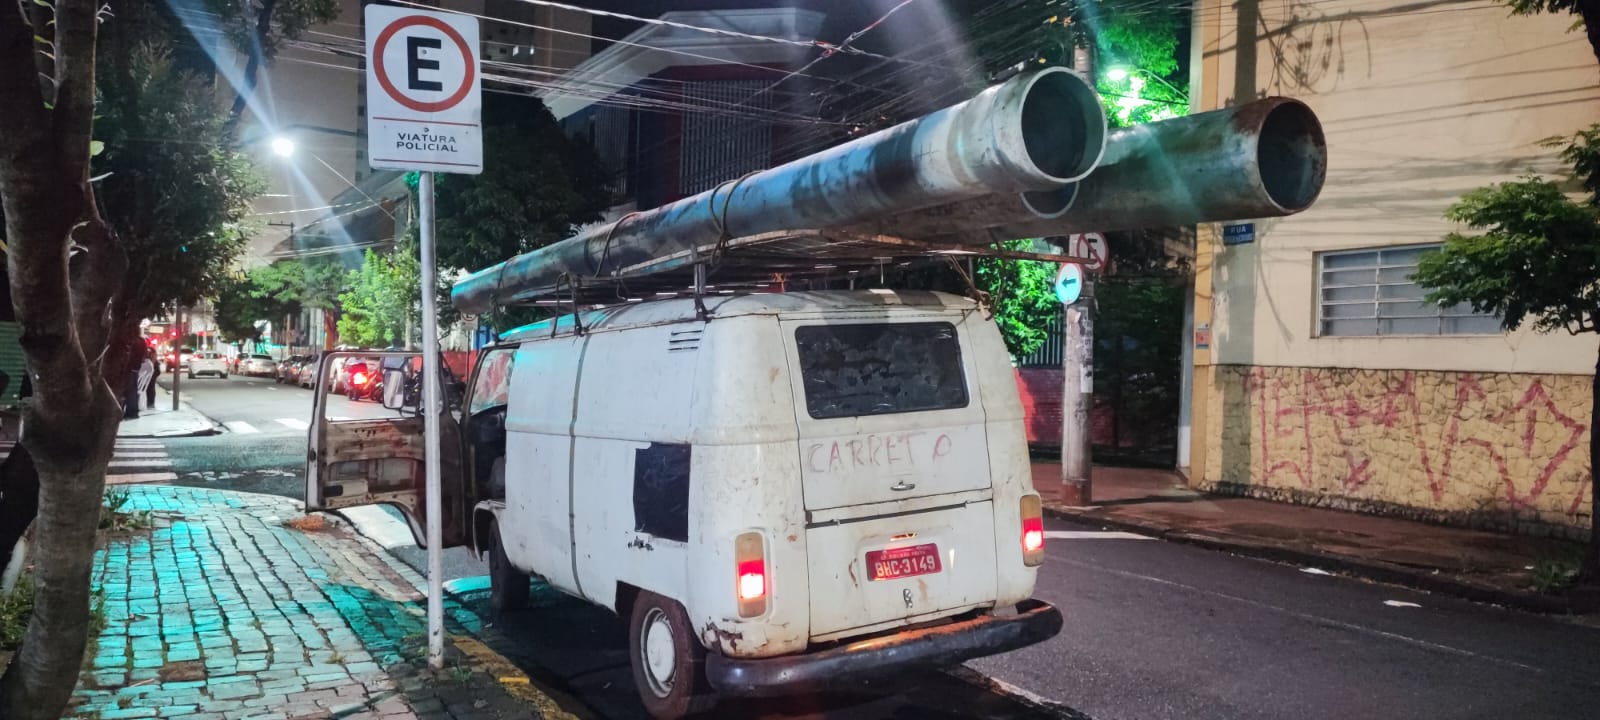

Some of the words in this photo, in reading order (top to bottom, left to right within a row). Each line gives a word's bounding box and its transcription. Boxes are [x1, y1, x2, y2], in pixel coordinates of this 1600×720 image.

[407, 36, 443, 92] E
[396, 141, 458, 153] POLICIAL
[398, 132, 457, 144] VIATURA
[874, 554, 937, 578] BHC-3149
